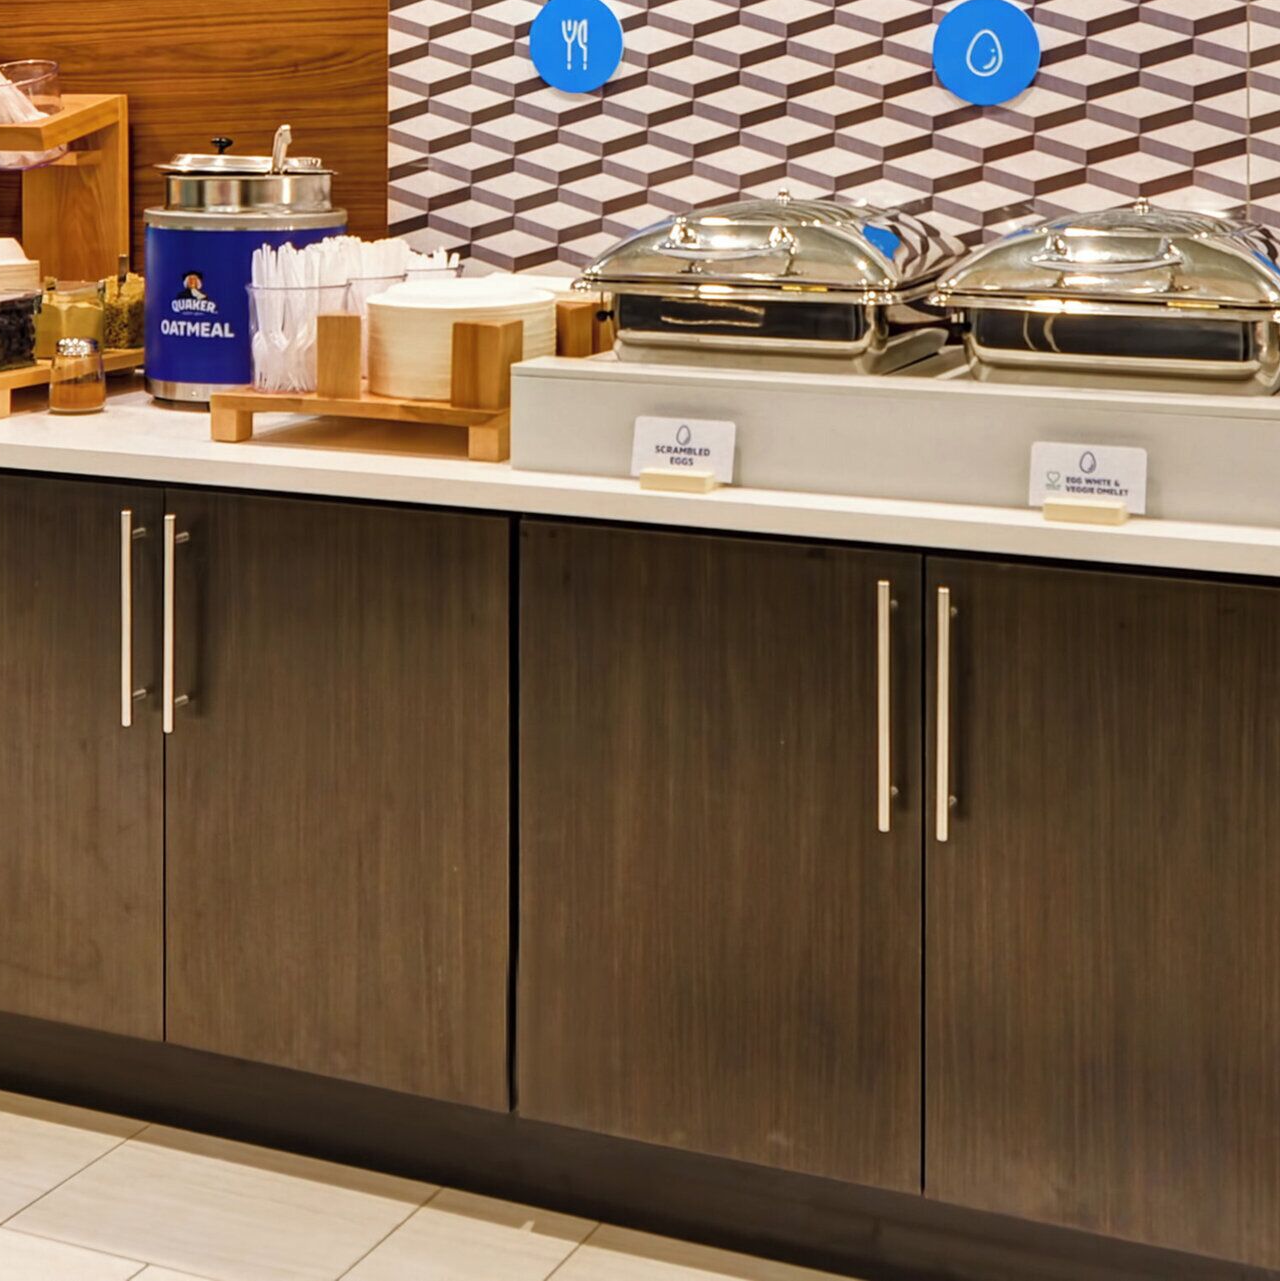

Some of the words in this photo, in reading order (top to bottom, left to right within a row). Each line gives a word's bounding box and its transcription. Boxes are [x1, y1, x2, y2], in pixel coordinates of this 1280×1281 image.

[171, 298, 217, 314] QUAKER
[160, 319, 235, 338] OATMEAL
[655, 445, 710, 457] SCRAMBLED
[669, 456, 694, 466] EGGS
[1085, 477, 1111, 486] WHITE
